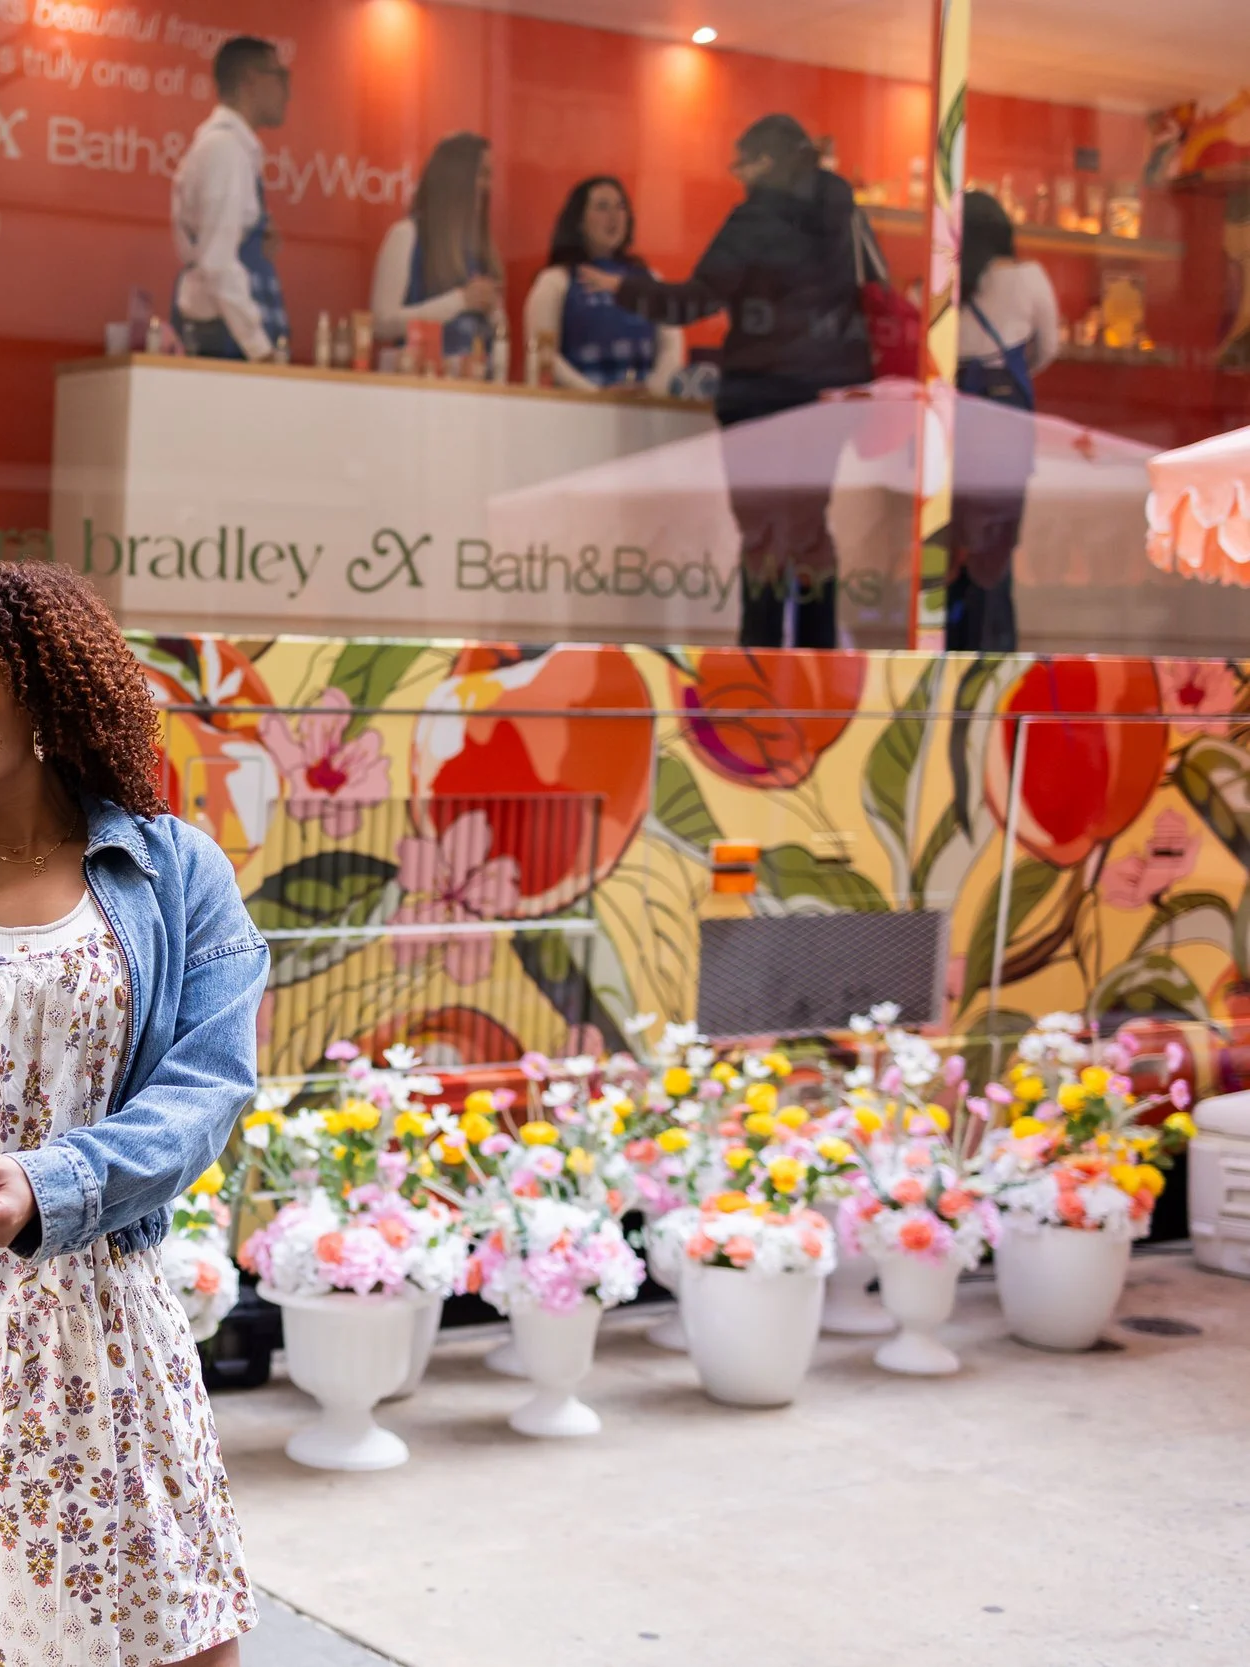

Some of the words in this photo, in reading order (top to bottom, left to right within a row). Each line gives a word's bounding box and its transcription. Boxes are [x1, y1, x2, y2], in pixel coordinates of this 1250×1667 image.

[33, 0, 162, 43] beautiful
[91, 58, 150, 92] one
[83, 518, 325, 600] bradley
